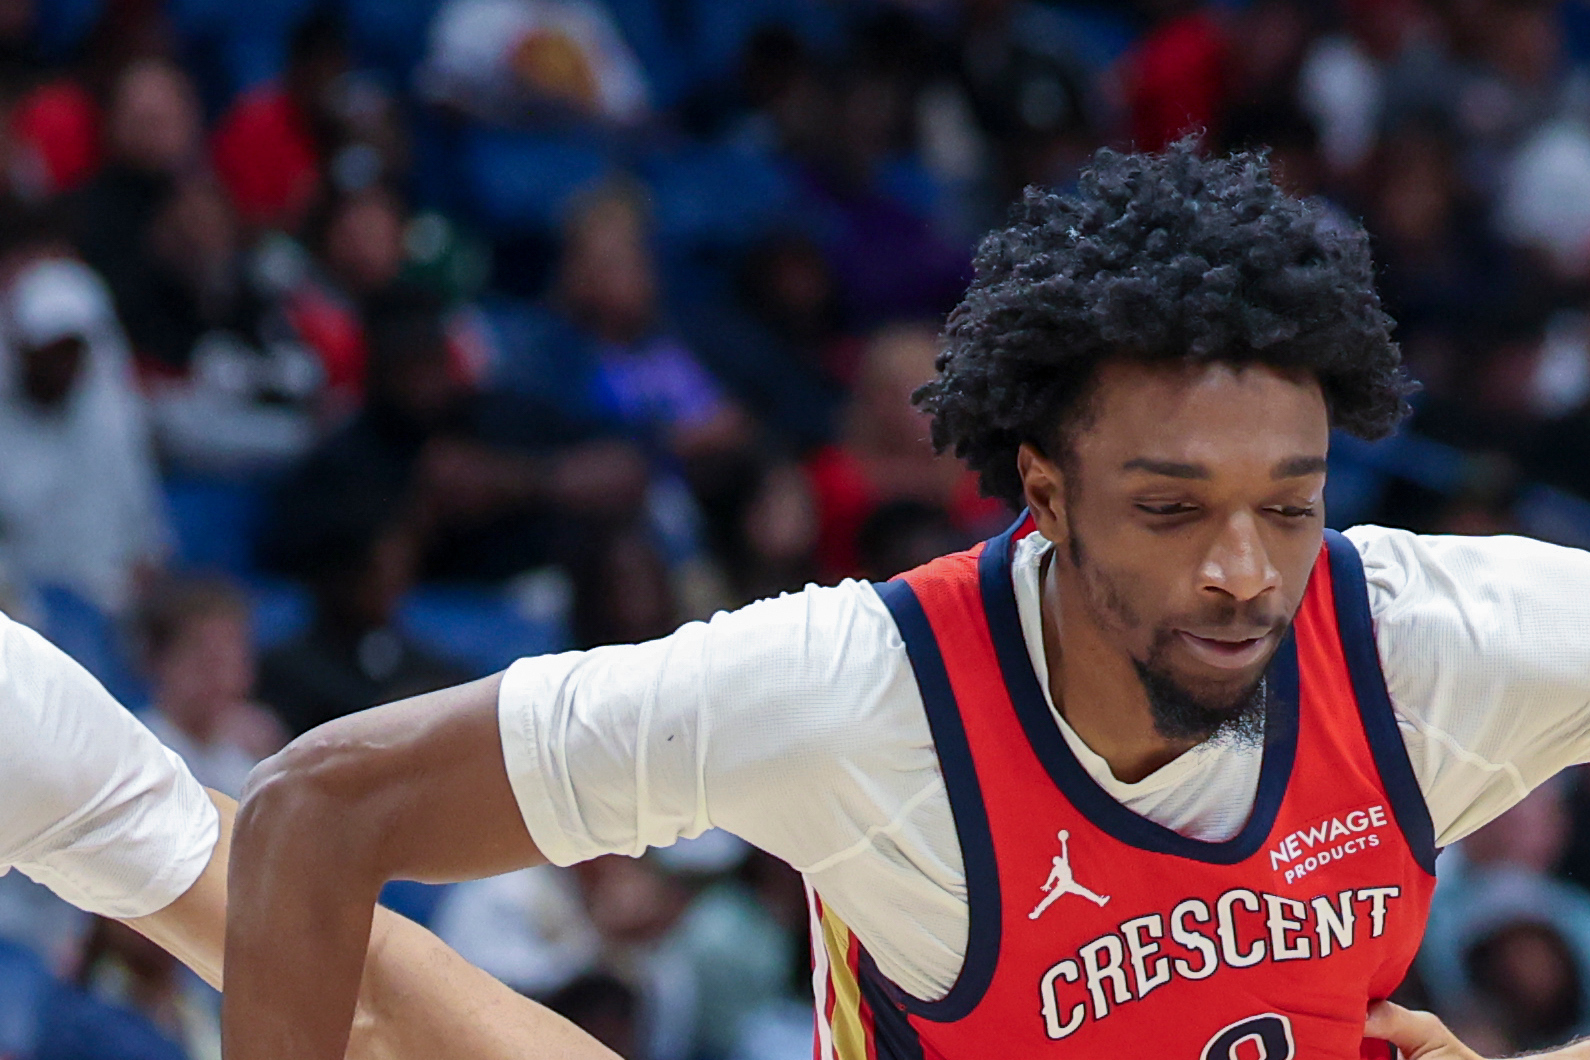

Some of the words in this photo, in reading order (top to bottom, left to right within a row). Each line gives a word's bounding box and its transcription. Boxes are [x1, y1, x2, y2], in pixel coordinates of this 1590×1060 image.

[1269, 805, 1388, 872] NEWAGE
[1284, 834, 1381, 885] PRODUCTS
[1039, 886, 1400, 1041] CRESCENT
